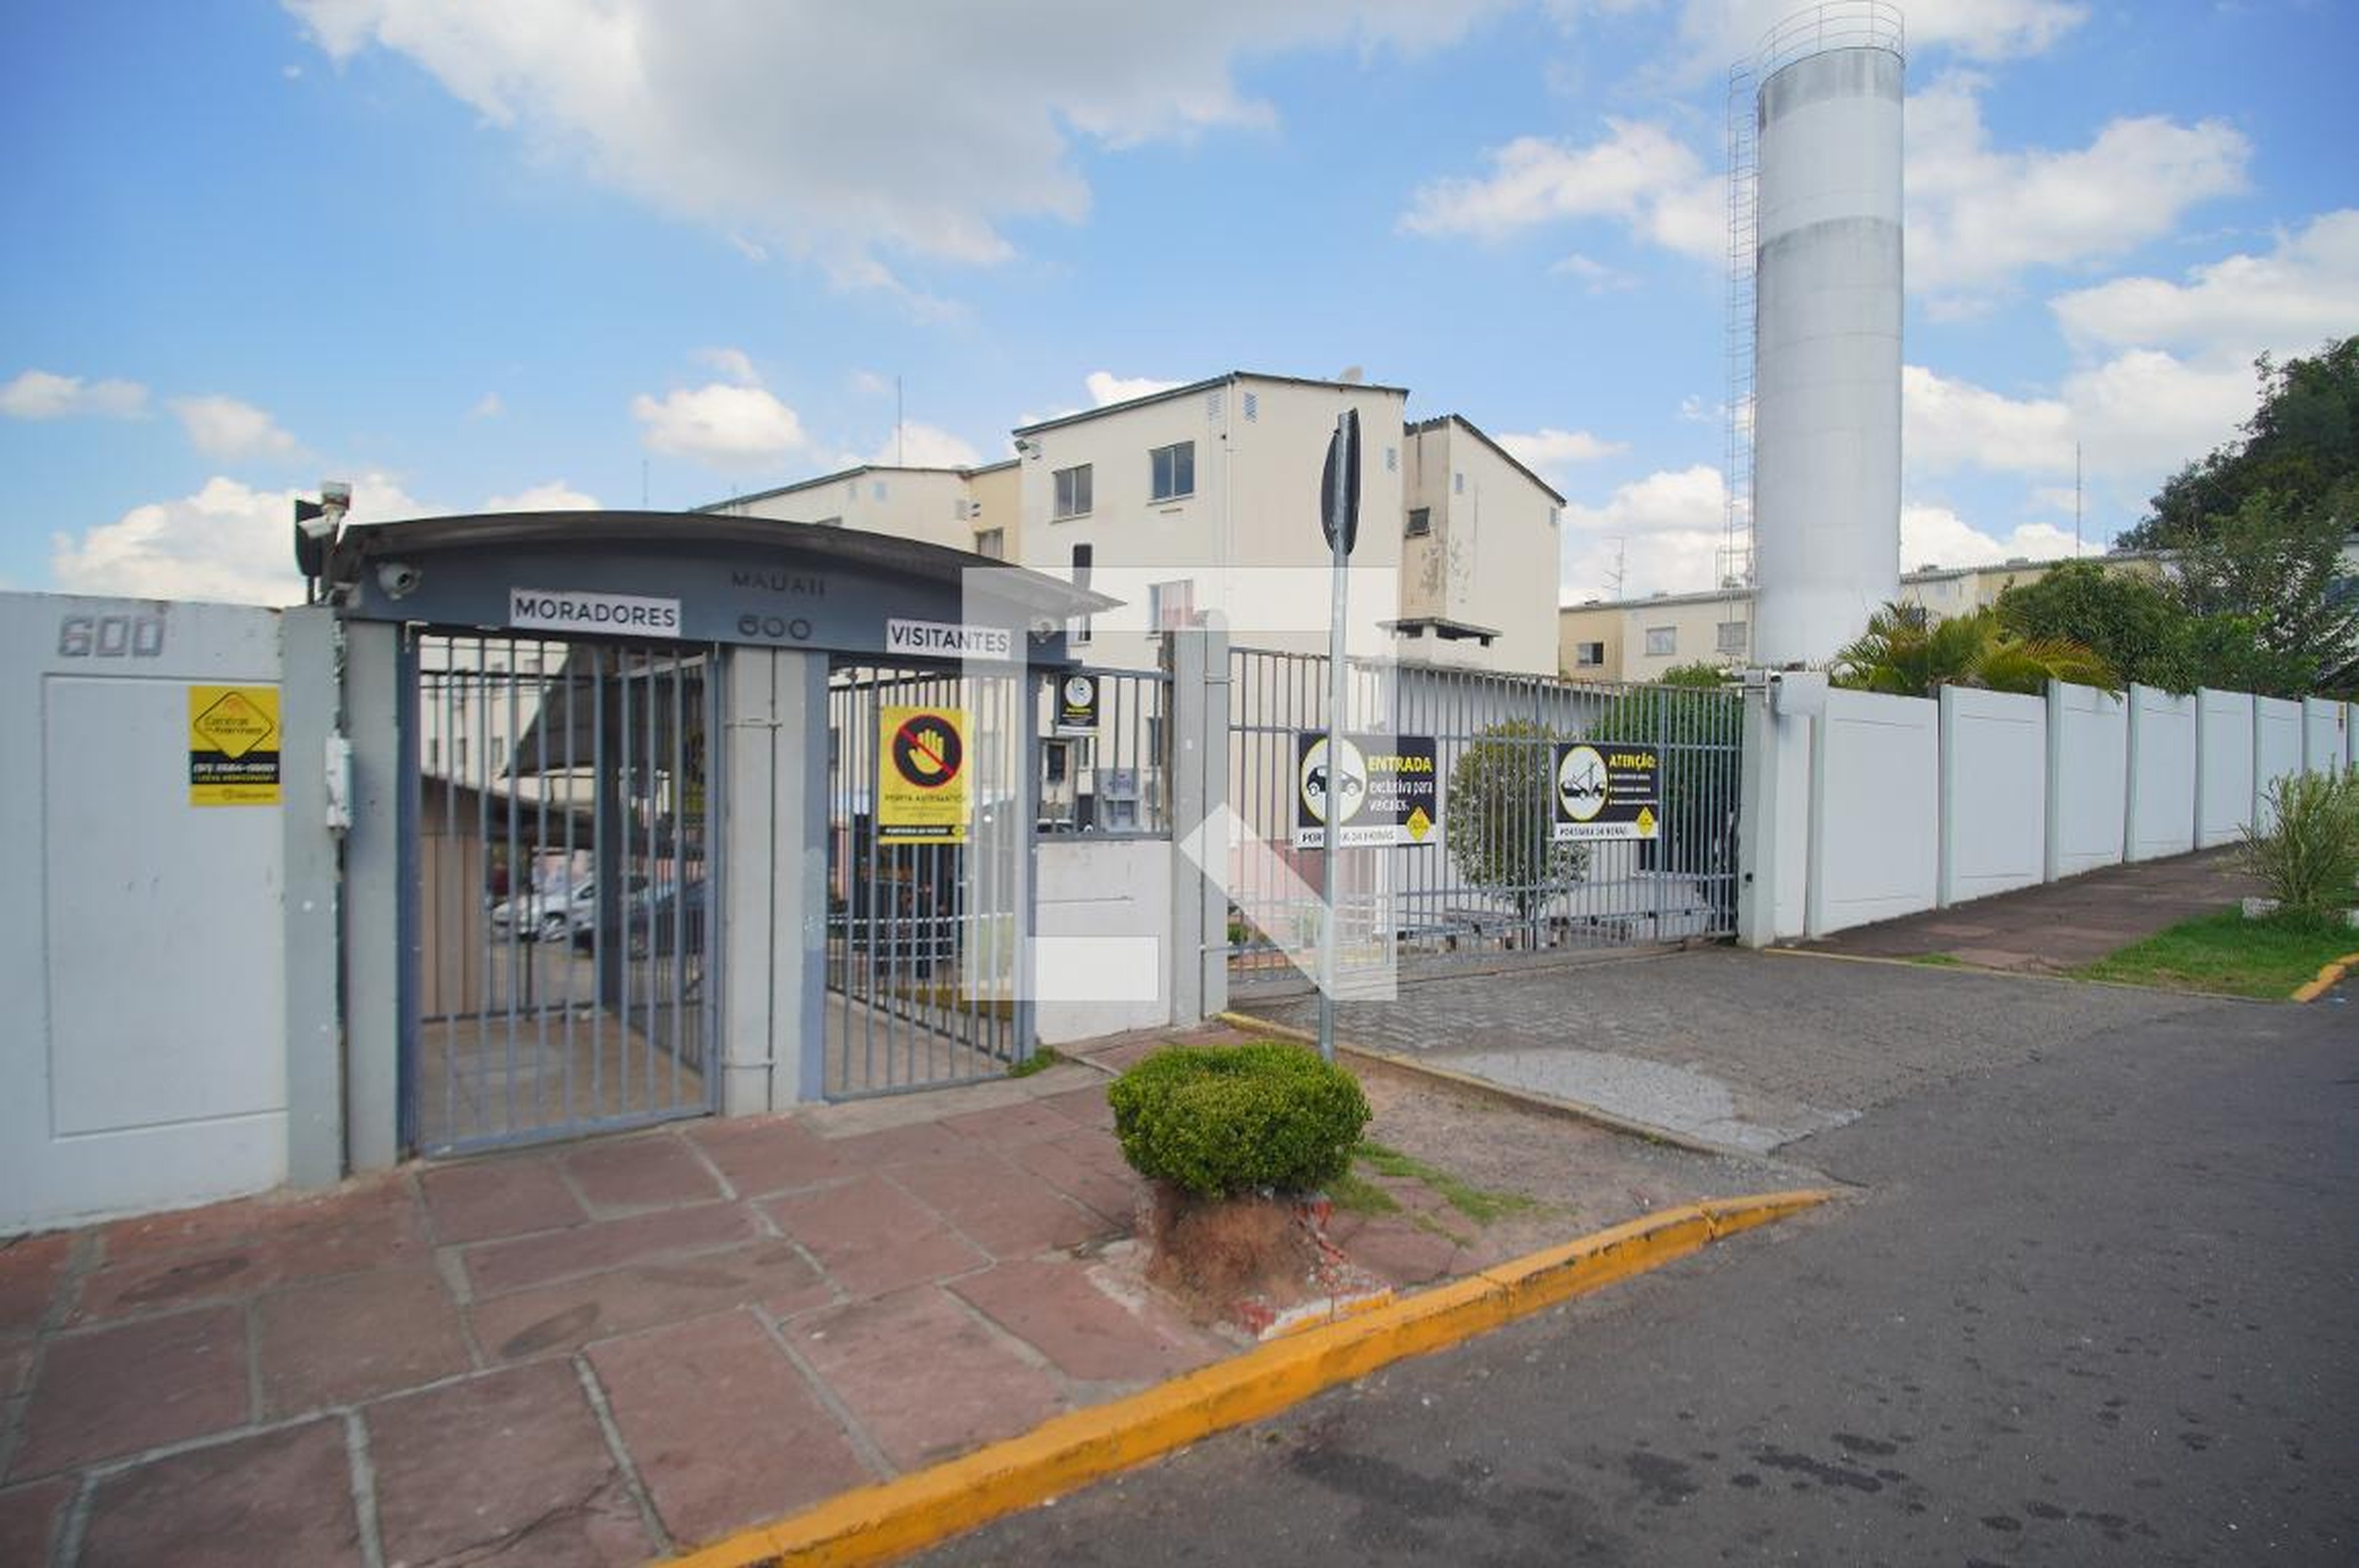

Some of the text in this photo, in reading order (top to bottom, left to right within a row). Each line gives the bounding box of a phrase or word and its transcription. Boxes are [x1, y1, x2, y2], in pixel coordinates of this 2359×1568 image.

[515, 598, 676, 627] MORADORES
[58, 614, 165, 657] 600
[737, 615, 812, 640] 600
[891, 625, 1007, 652] VISITANTES
[1368, 755, 1433, 773] ENTRADA
